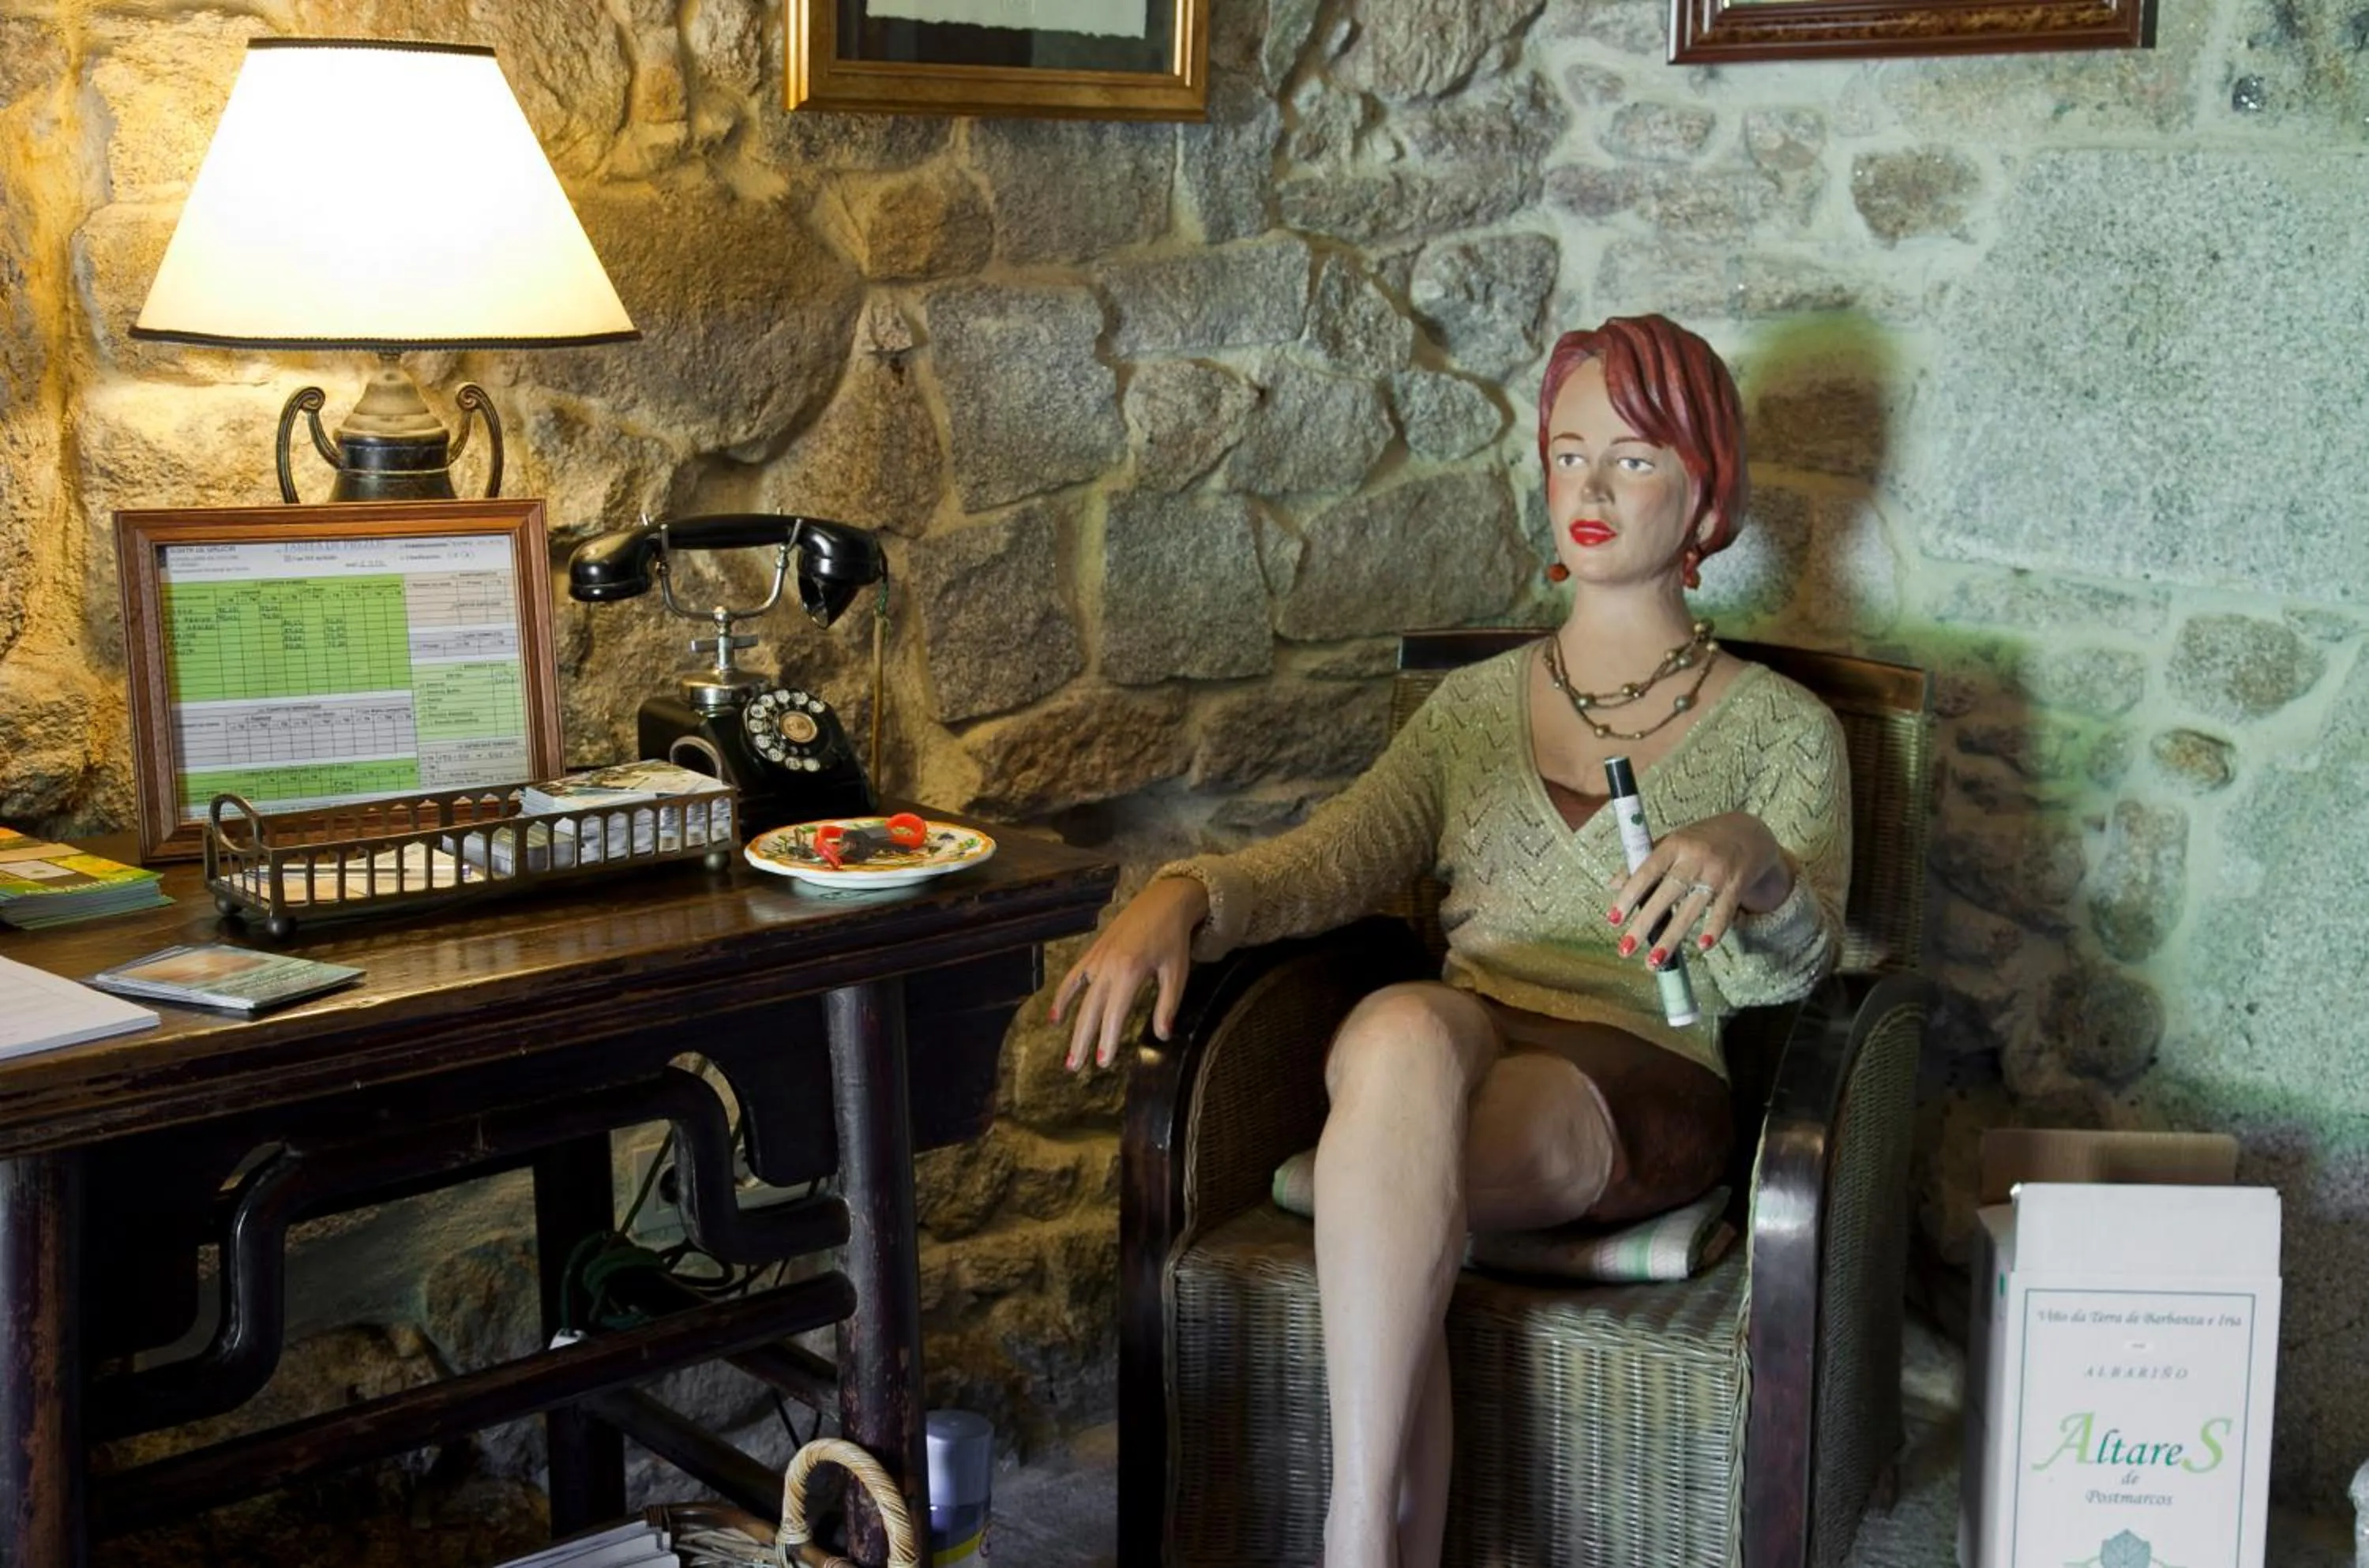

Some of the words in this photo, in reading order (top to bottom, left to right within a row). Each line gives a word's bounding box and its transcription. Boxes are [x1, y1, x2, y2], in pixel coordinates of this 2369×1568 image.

[2071, 1307, 2086, 1322] da
[2089, 1311, 2122, 1323] Terra
[2125, 1310, 2140, 1324] de
[2085, 1364, 2189, 1379] ALBARIÑO
[2031, 1411, 2234, 1473] AltareS
[2121, 1469, 2140, 1485] de
[2086, 1489, 2174, 1506] Postmarcos
